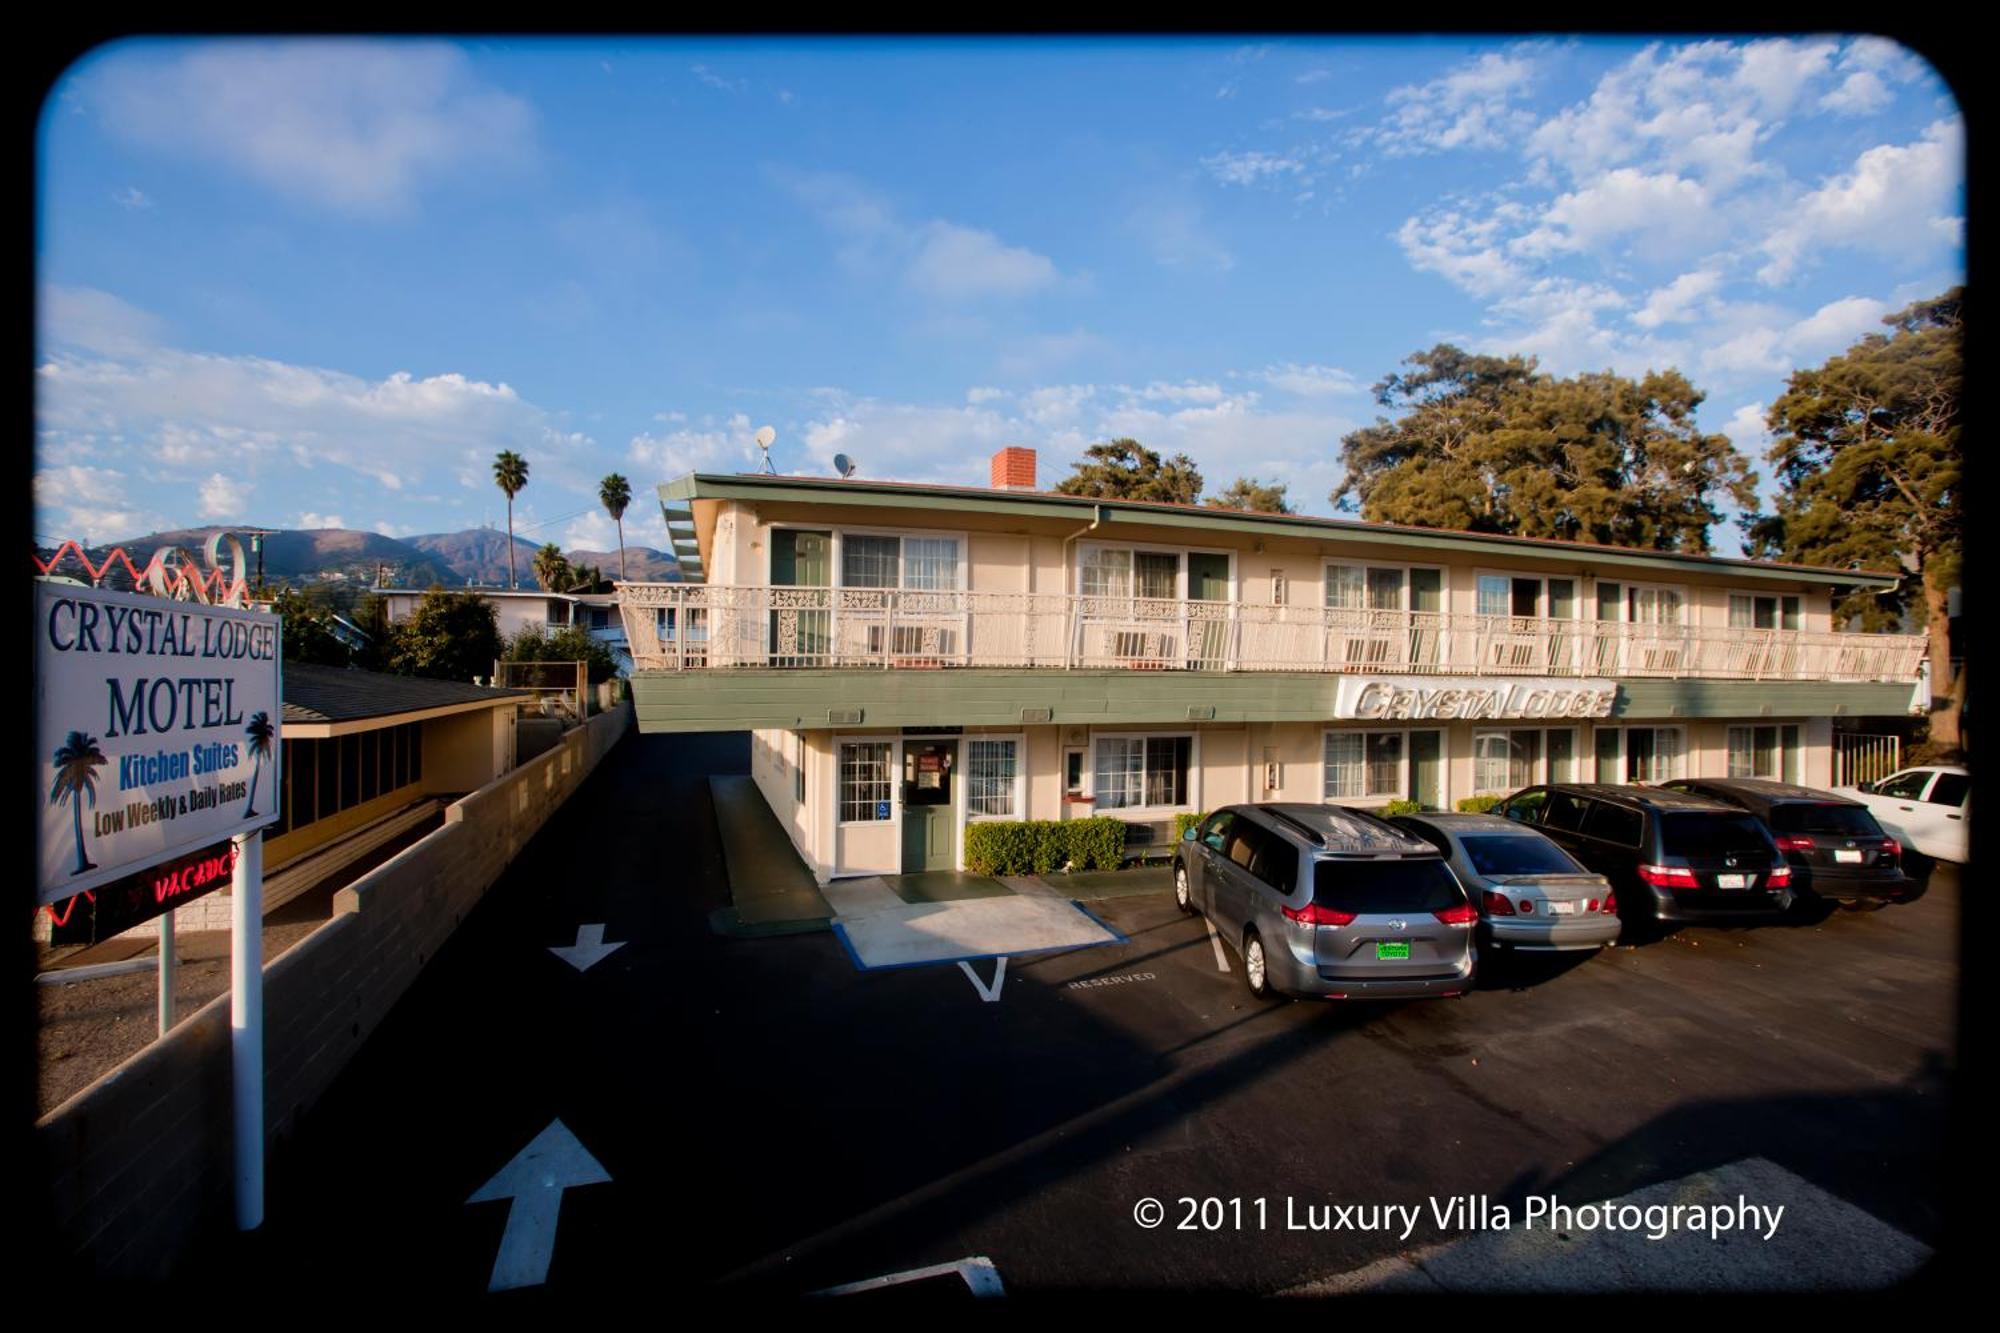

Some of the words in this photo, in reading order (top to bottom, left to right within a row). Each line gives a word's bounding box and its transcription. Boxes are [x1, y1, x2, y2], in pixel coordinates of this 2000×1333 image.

[50, 600, 194, 656] CRYSTAL
[203, 618, 273, 660] LODGE
[105, 677, 243, 737] MOTEL
[119, 750, 190, 791] Kitchen
[193, 742, 239, 775] Suites
[94, 810, 124, 838] Low
[127, 796, 177, 829] Weekly
[178, 795, 188, 815] &
[190, 786, 217, 813] Daily
[219, 781, 247, 804] Rates
[1068, 972, 1156, 989] RESERVED
